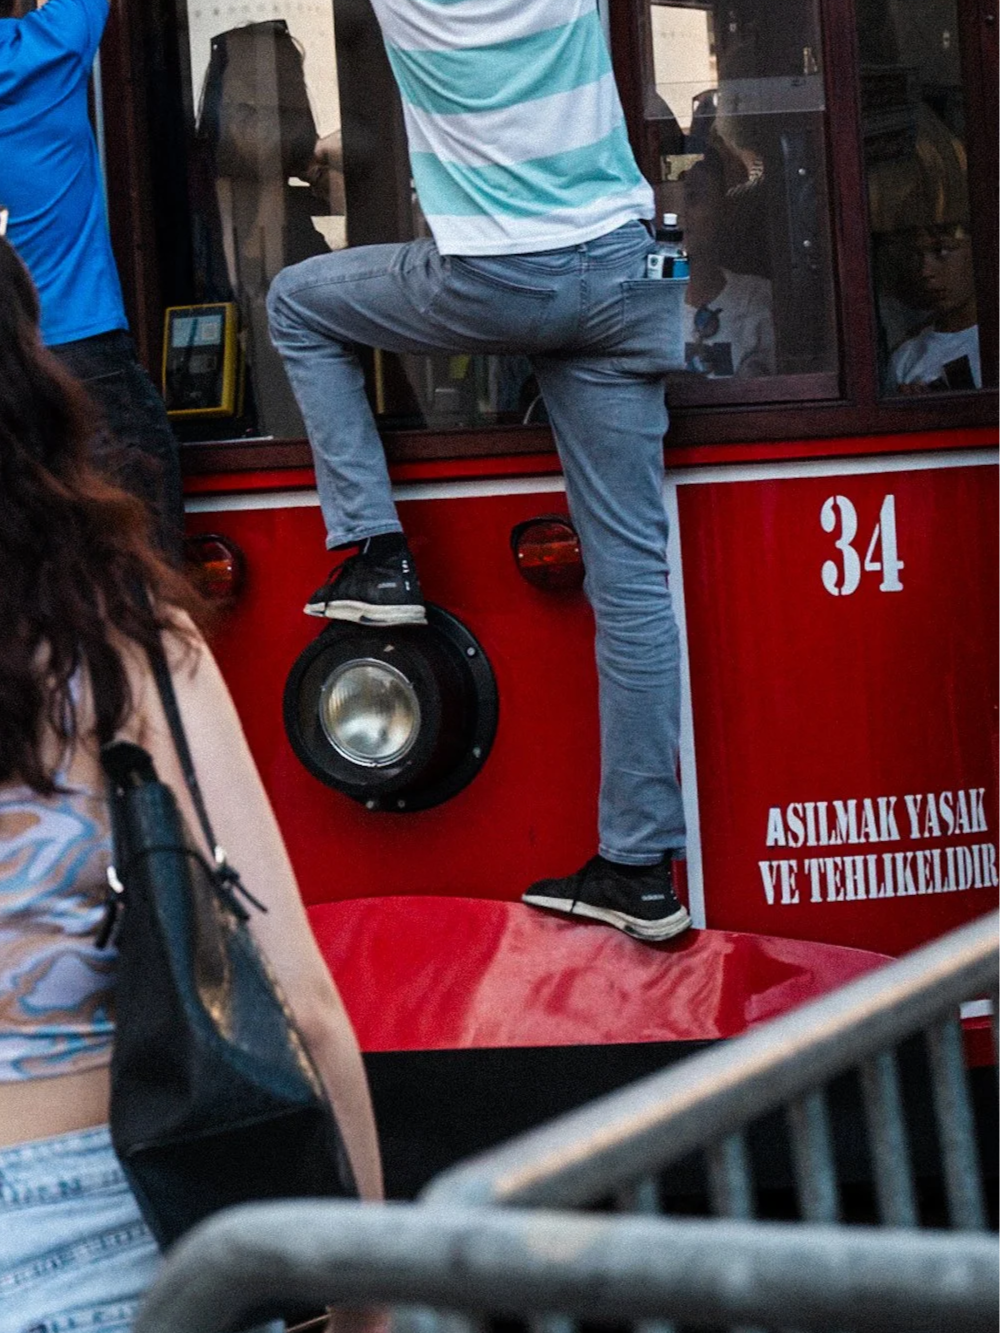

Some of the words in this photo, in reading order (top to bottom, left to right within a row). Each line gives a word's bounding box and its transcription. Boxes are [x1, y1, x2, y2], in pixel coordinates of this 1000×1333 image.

[820, 494, 905, 597] 34
[765, 796, 901, 849] ASILMAK
[904, 787, 989, 840] YASAK
[758, 859, 800, 905] VE
[804, 842, 1000, 903] TEHLIKELIDIR
